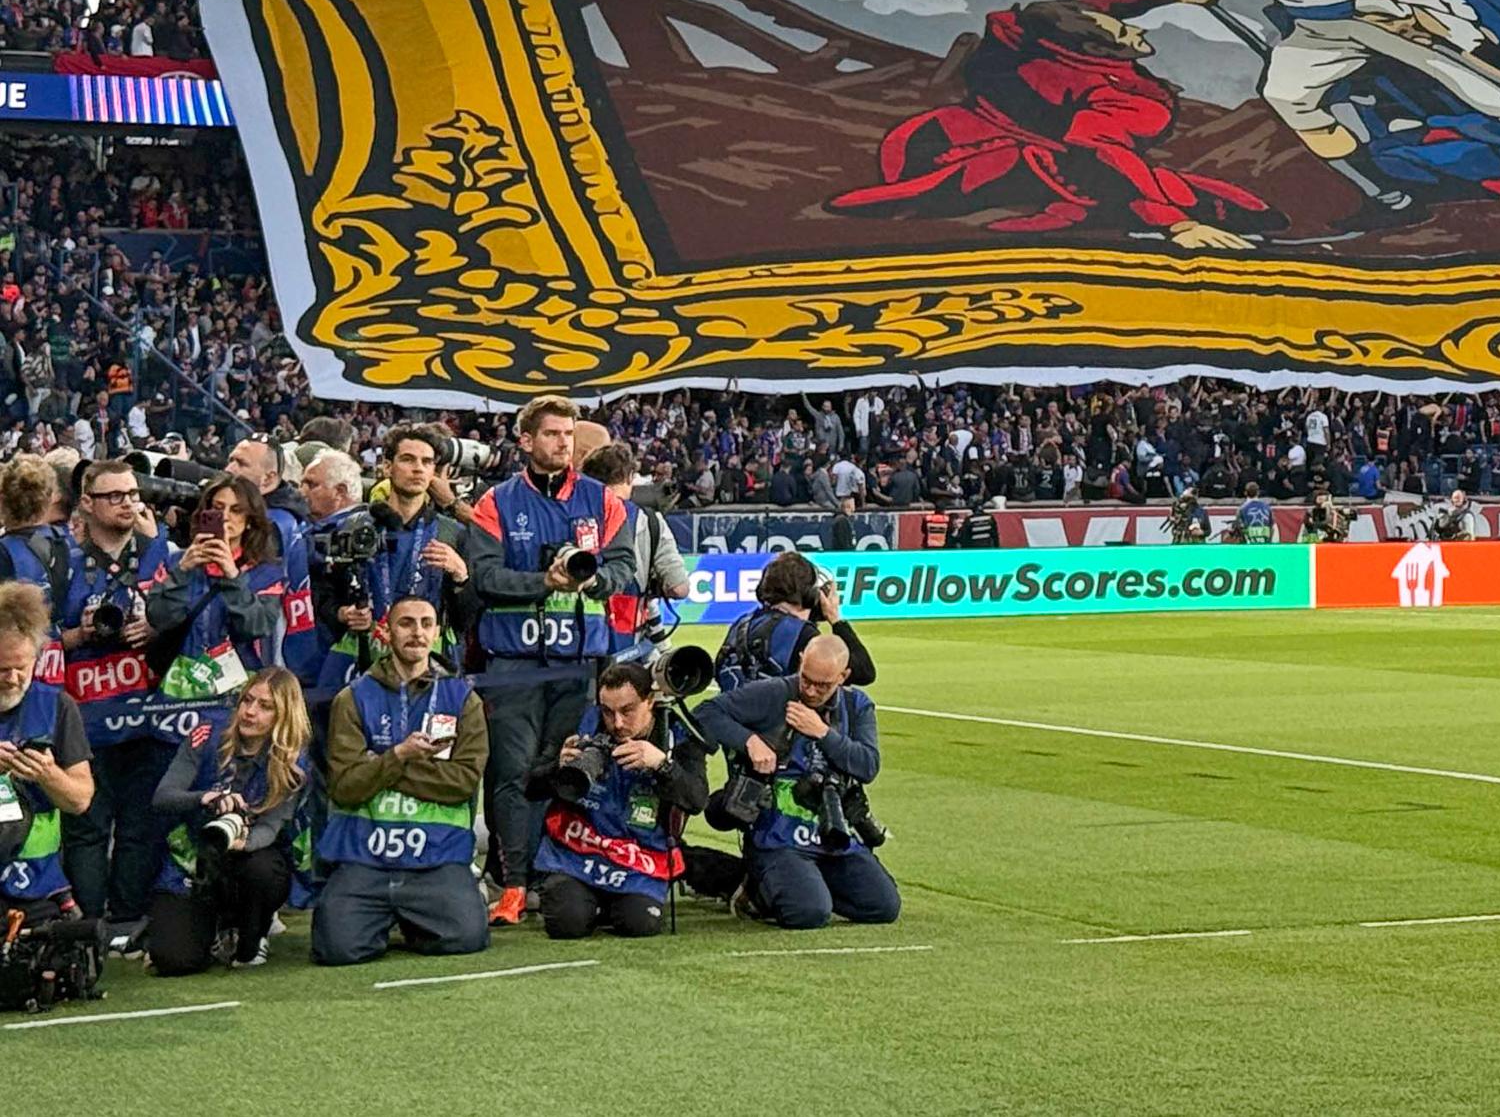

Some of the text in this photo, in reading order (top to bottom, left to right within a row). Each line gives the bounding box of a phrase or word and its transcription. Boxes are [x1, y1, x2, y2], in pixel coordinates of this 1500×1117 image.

[687, 569, 762, 603] CLE
[76, 654, 146, 697] PHO
[367, 826, 427, 858] 059
